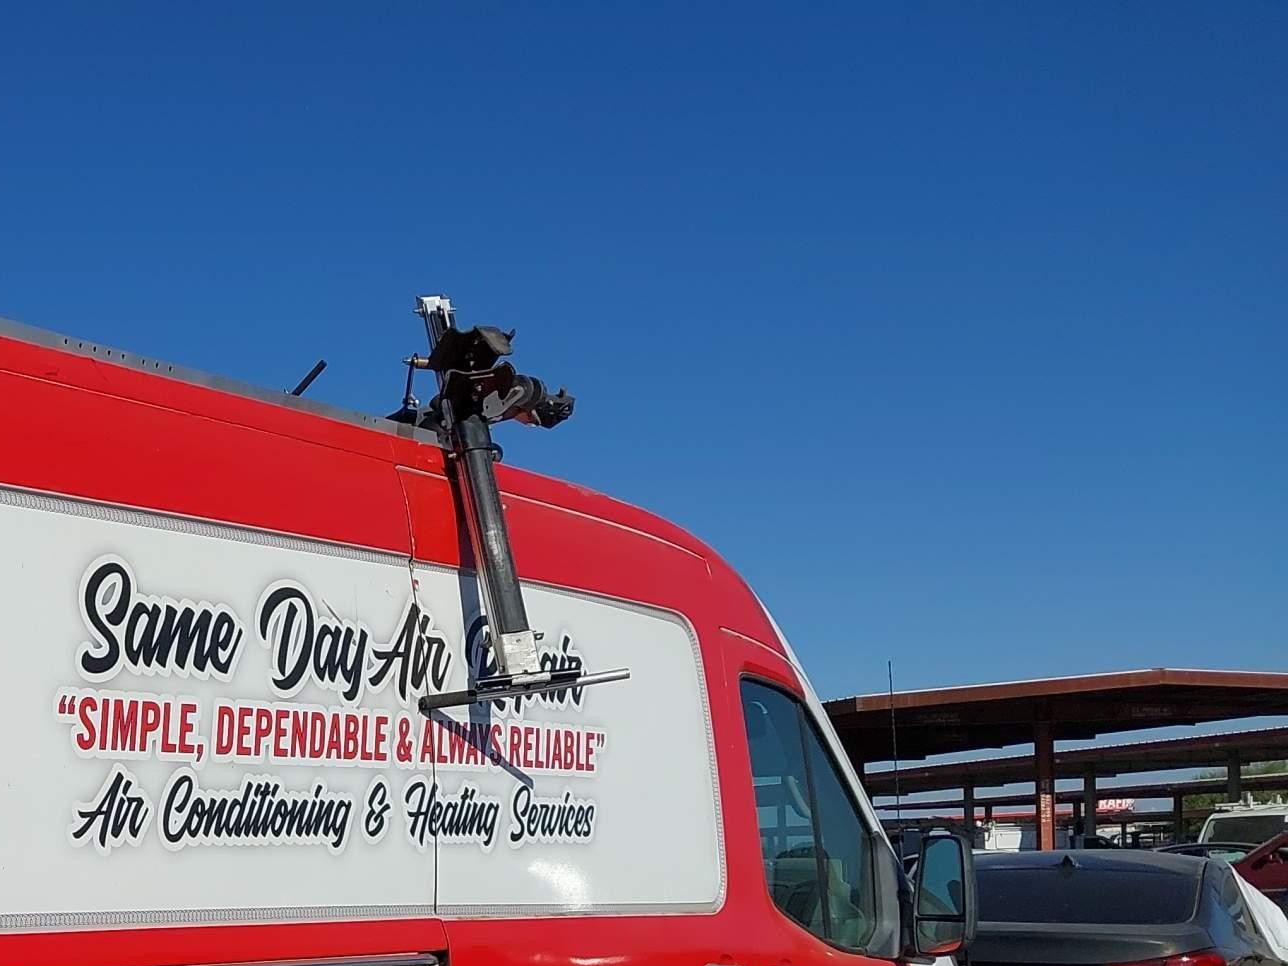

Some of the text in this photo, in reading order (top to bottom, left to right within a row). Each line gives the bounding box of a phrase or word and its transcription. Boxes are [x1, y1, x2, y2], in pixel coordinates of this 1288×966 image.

[82, 563, 240, 674] Same
[259, 587, 368, 701] Day
[368, 604, 451, 691] Air
[58, 695, 605, 771] “SIMPLE, DEPENDABLE & ALWAYS RELIABLE”
[72, 772, 592, 849] Air Conditioning & Heating Services
